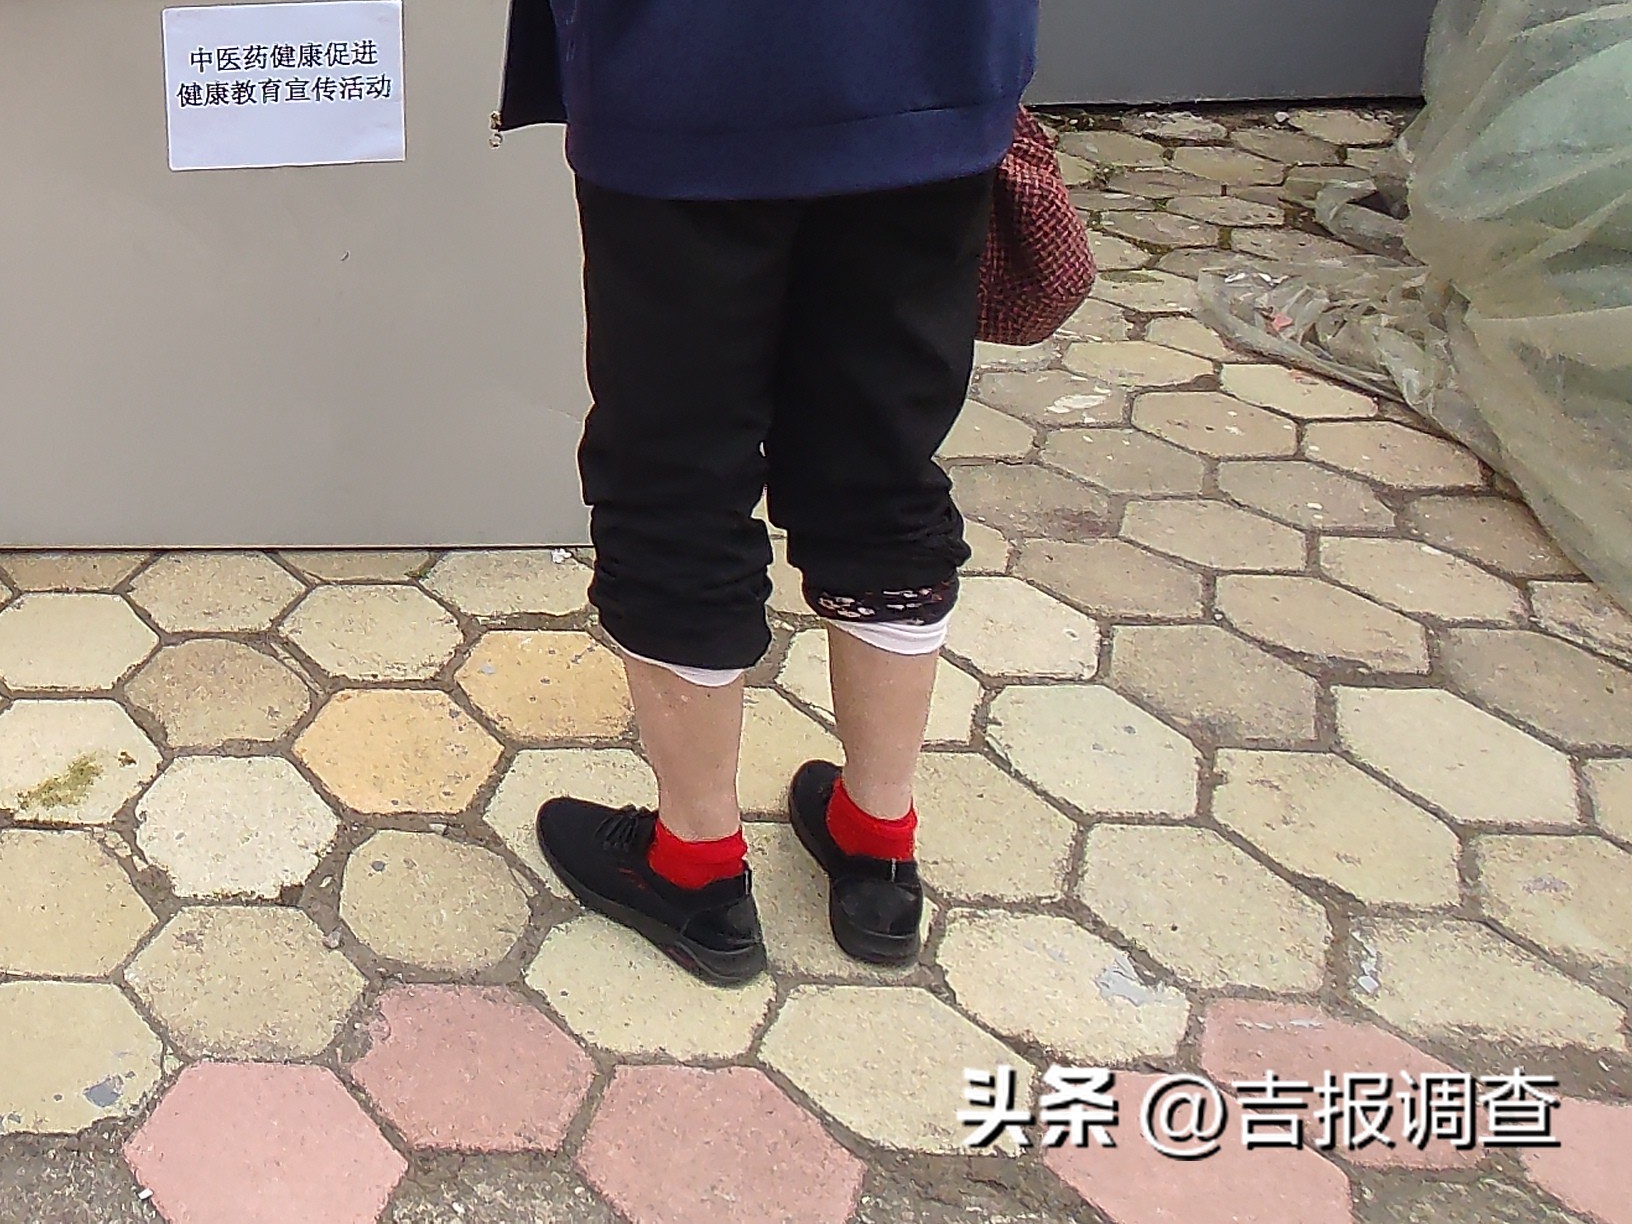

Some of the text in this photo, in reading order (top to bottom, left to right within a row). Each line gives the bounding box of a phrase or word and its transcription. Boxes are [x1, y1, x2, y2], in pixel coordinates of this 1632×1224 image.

[190, 40, 379, 73] 中医药健康促进
[176, 74, 392, 107] 健康教育宣传活动
